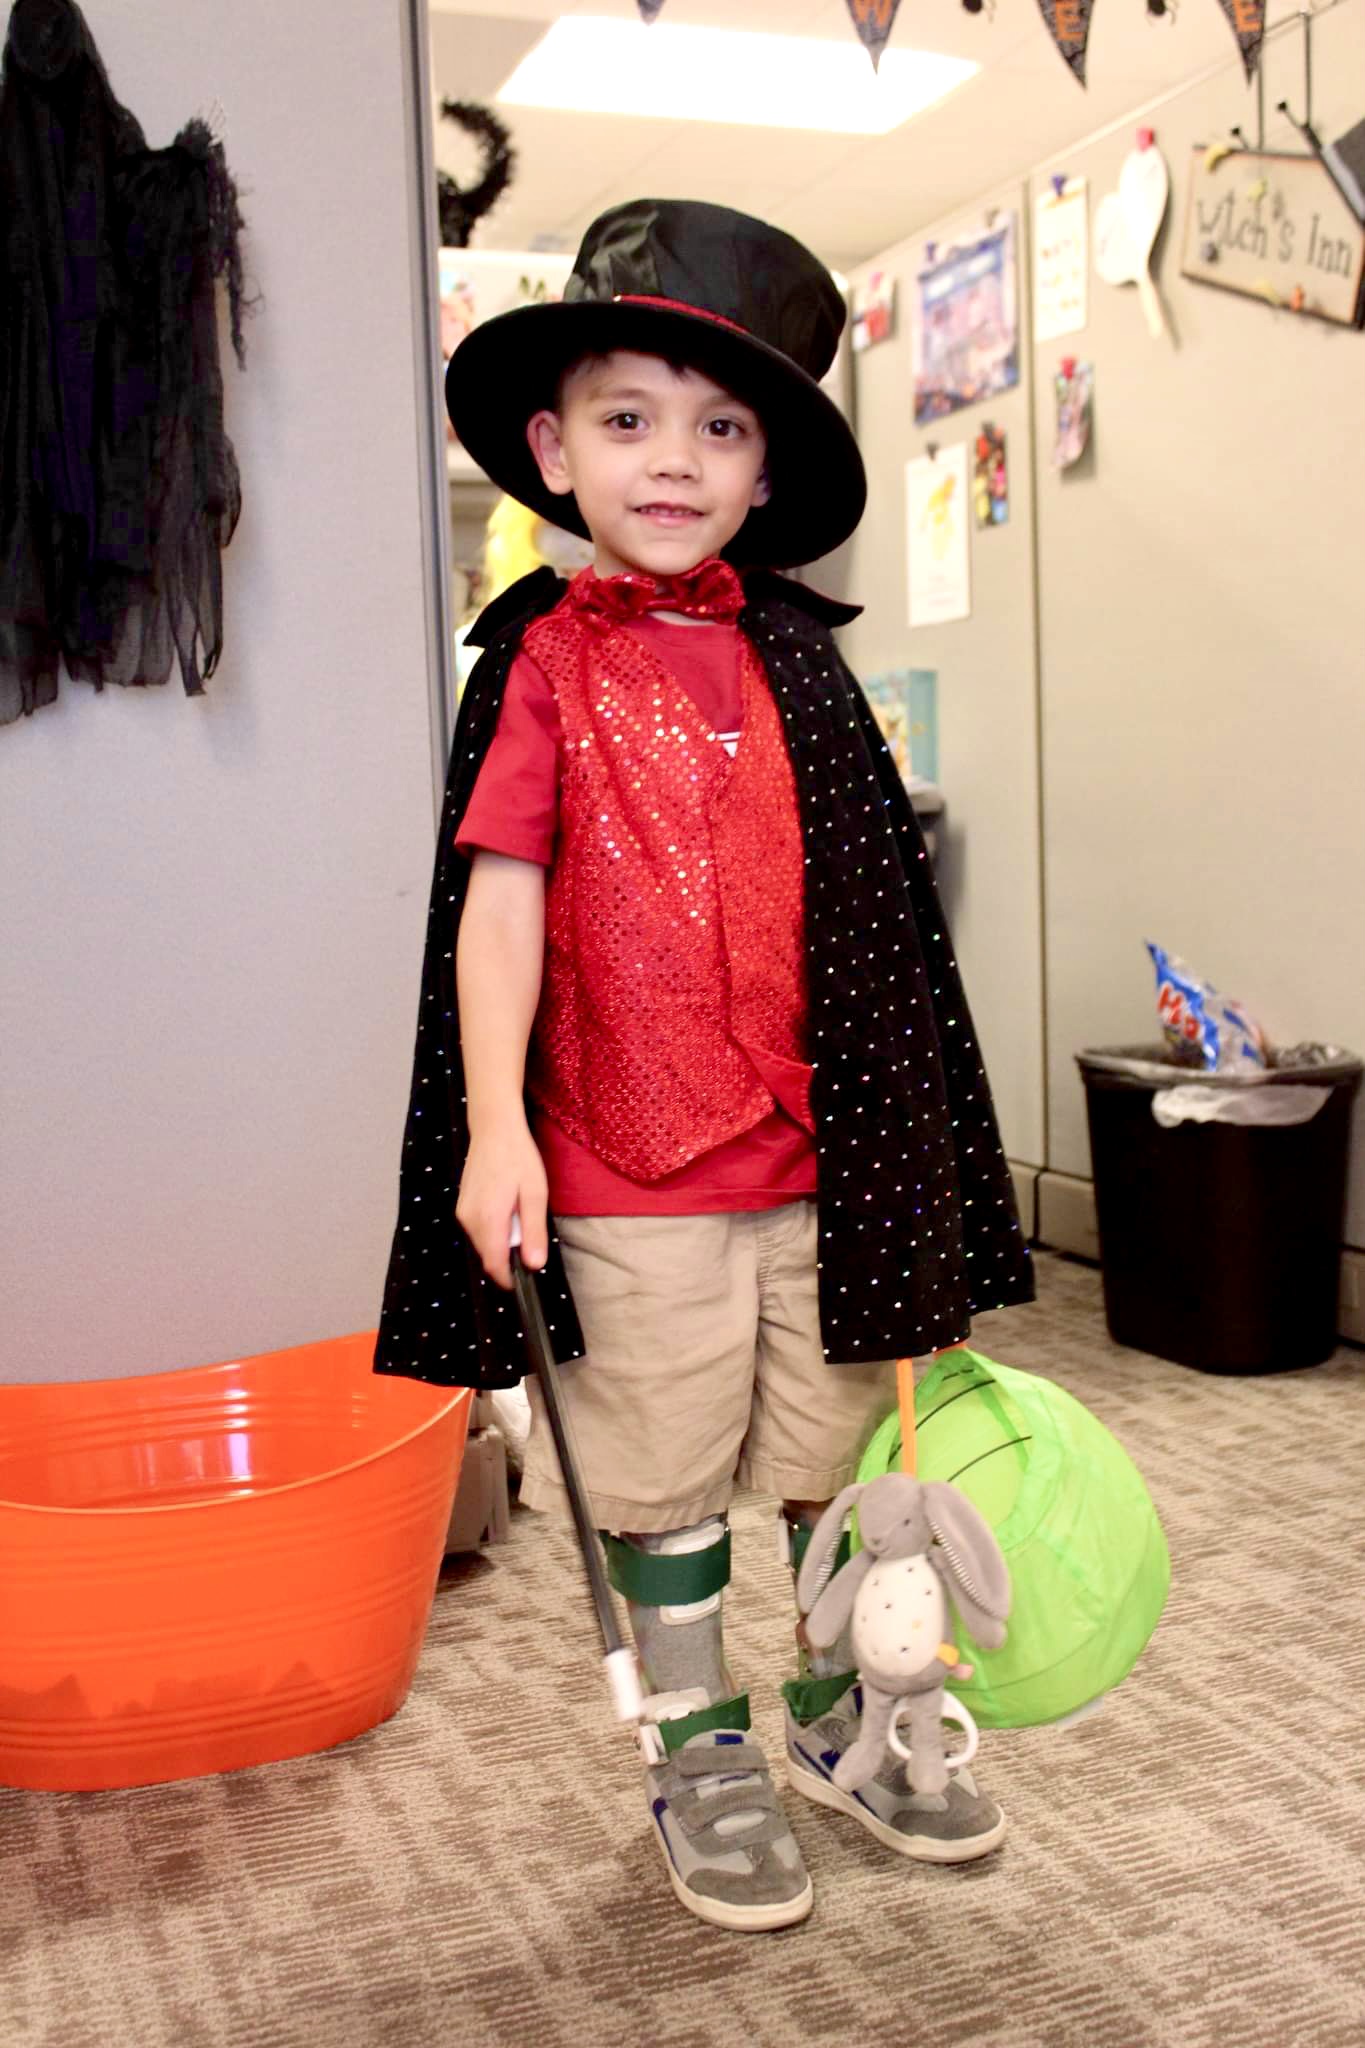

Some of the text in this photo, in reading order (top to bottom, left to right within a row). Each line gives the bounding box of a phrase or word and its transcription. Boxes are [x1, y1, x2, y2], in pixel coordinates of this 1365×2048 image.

[1055, 0, 1083, 41] E
[1232, 0, 1260, 32] E
[1305, 212, 1354, 278] Inn
